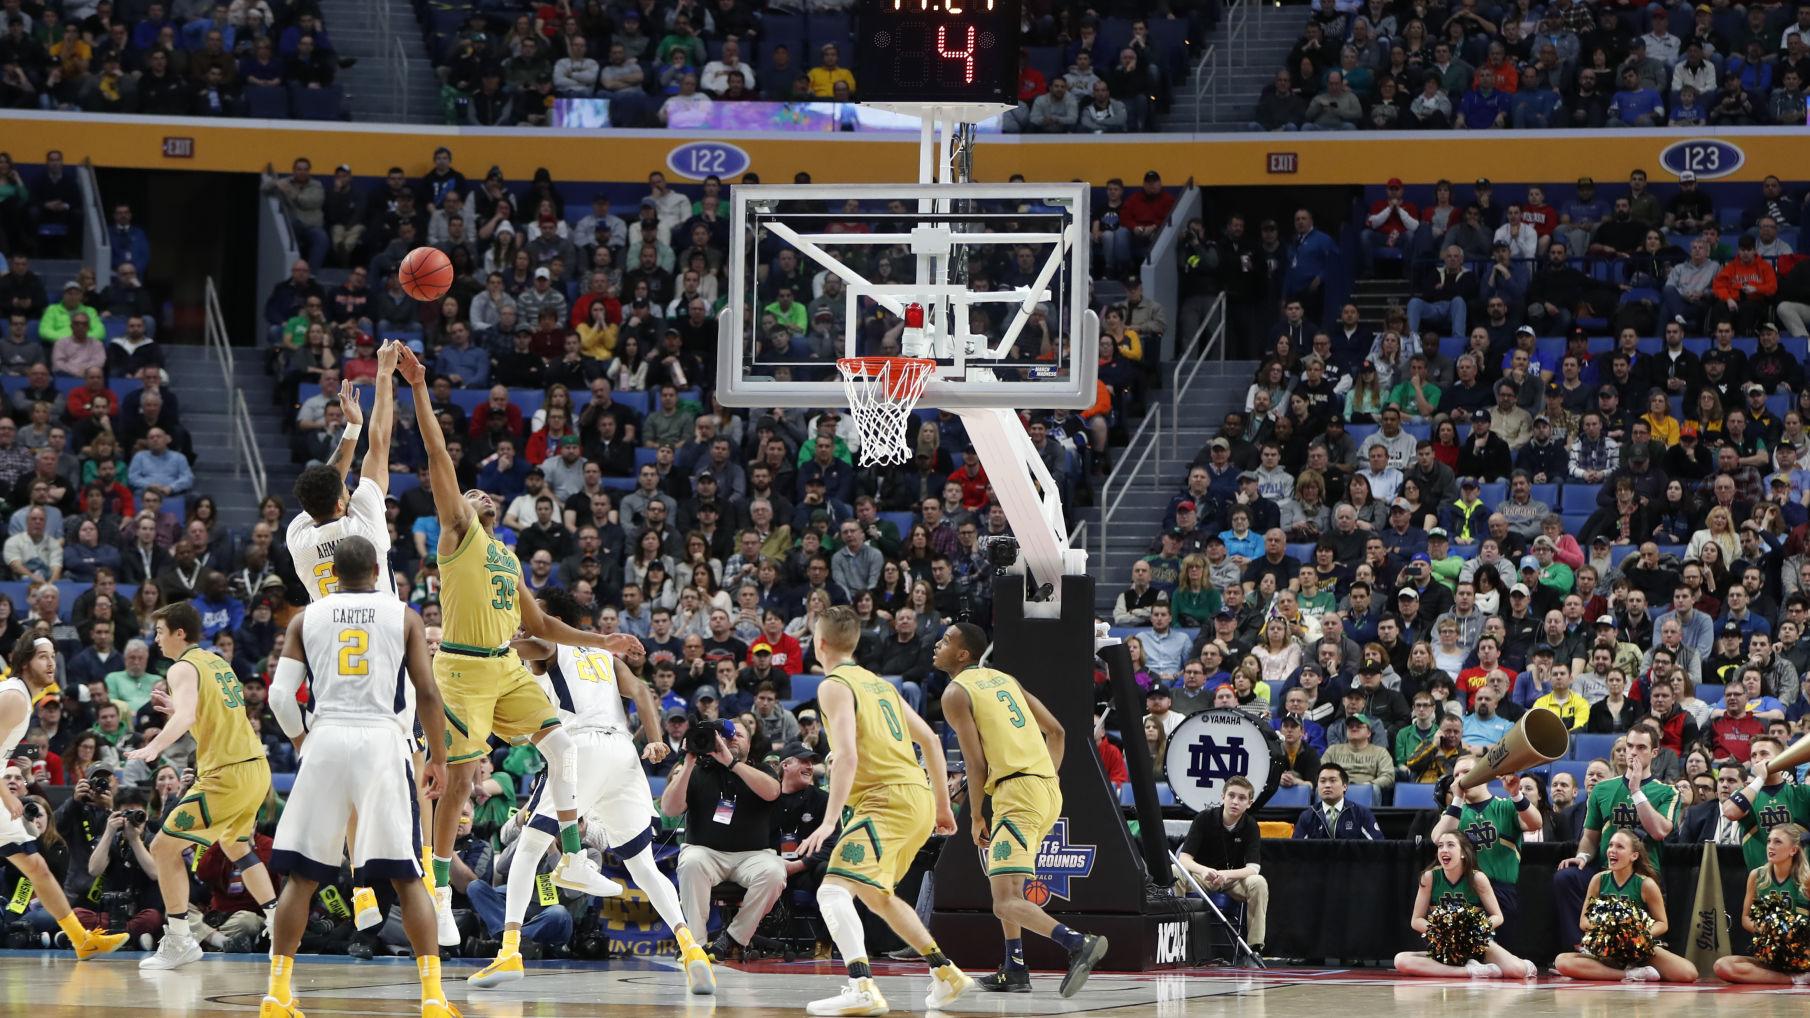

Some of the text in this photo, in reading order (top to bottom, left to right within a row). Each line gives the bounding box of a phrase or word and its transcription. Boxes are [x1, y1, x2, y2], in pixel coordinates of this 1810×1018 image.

[937, 25, 975, 84] 4
[166, 138, 193, 156] EXIT
[1684, 145, 1720, 171] 123
[691, 148, 726, 172] 122
[1270, 154, 1297, 171] EXIT
[316, 537, 345, 560] AHM
[332, 608, 376, 624] CARTER
[337, 627, 370, 676] 2
[878, 698, 903, 742] 0
[996, 689, 1026, 729] 3
[1210, 714, 1241, 725] YAMAHA
[1037, 854, 1087, 868] ROUNDS
[539, 872, 555, 901] ONSHIPS
[1156, 920, 1189, 964] NCAA
